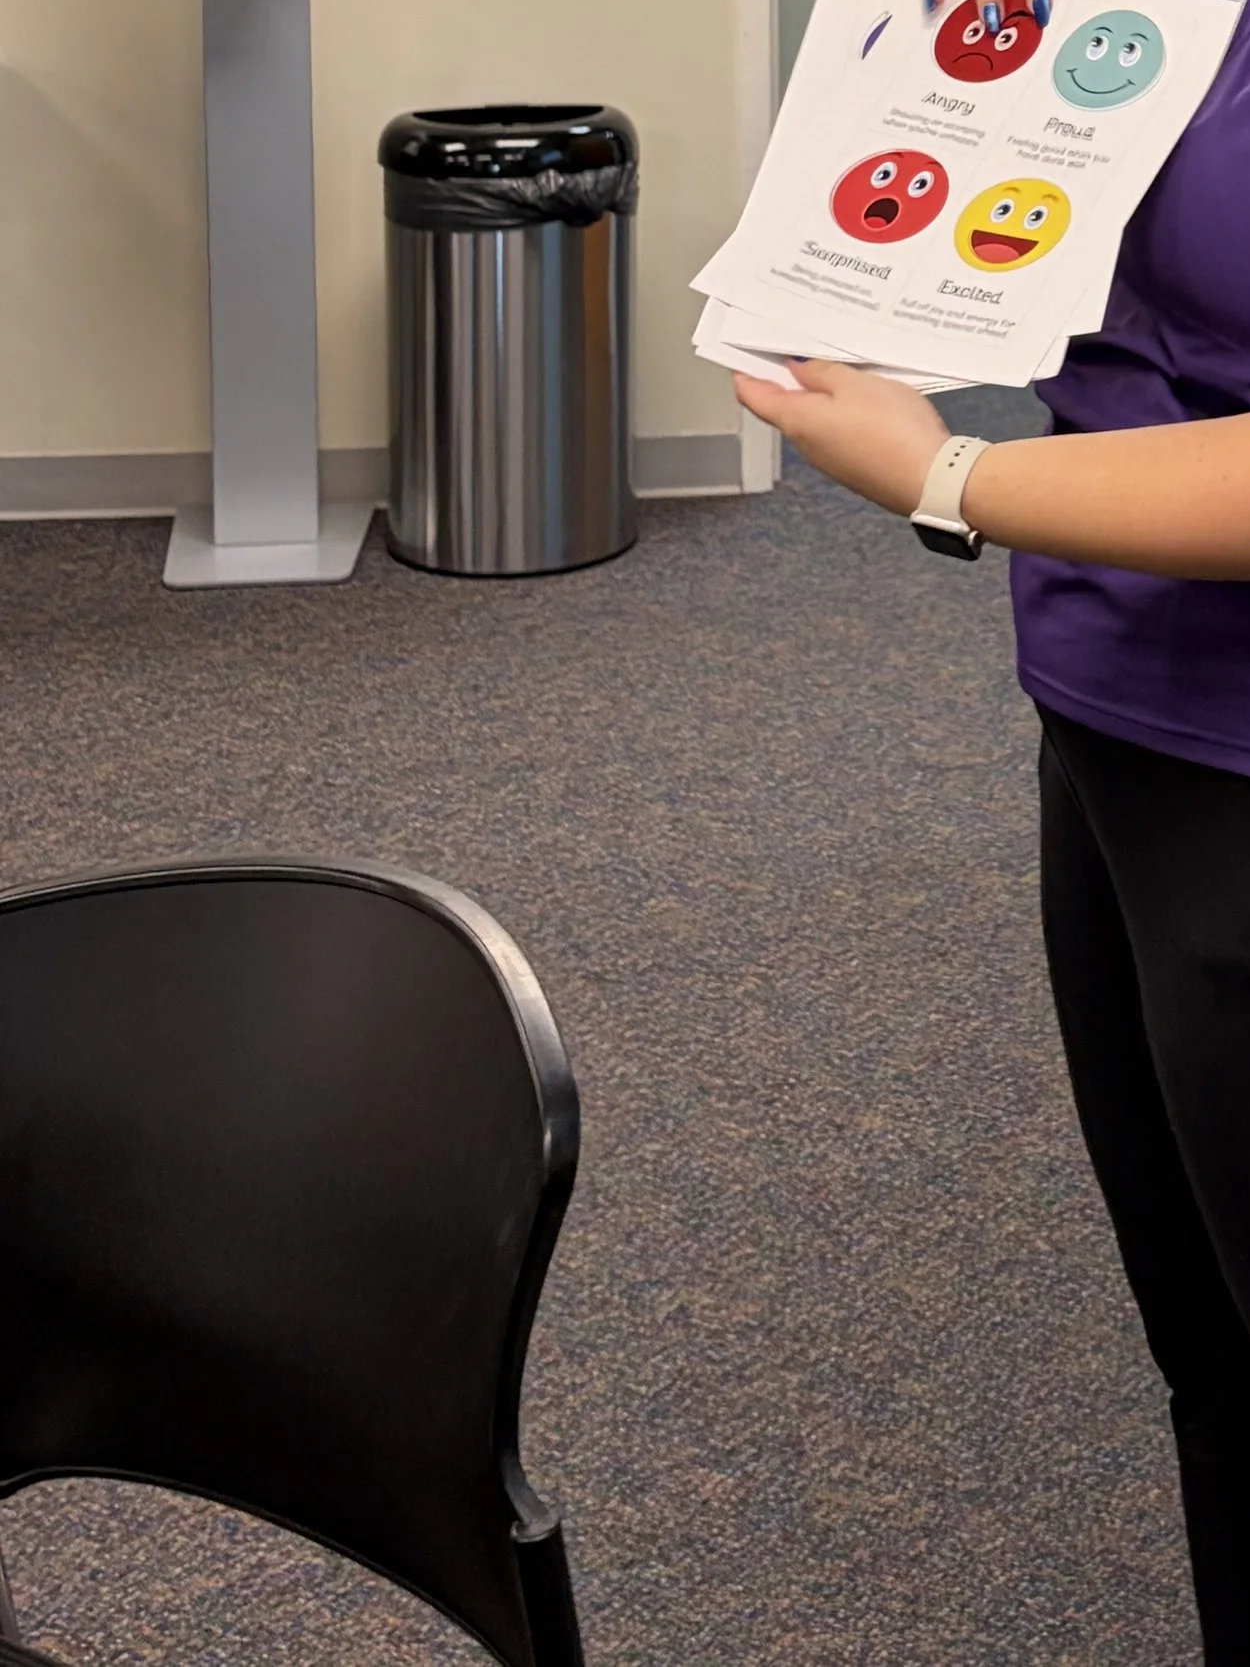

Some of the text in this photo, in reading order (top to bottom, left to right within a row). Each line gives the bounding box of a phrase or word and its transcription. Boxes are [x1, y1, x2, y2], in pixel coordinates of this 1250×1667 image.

[921, 91, 976, 116] Angry
[1043, 117, 1096, 141] Proud
[799, 240, 893, 280] Surprised
[937, 278, 1004, 305] Excited
